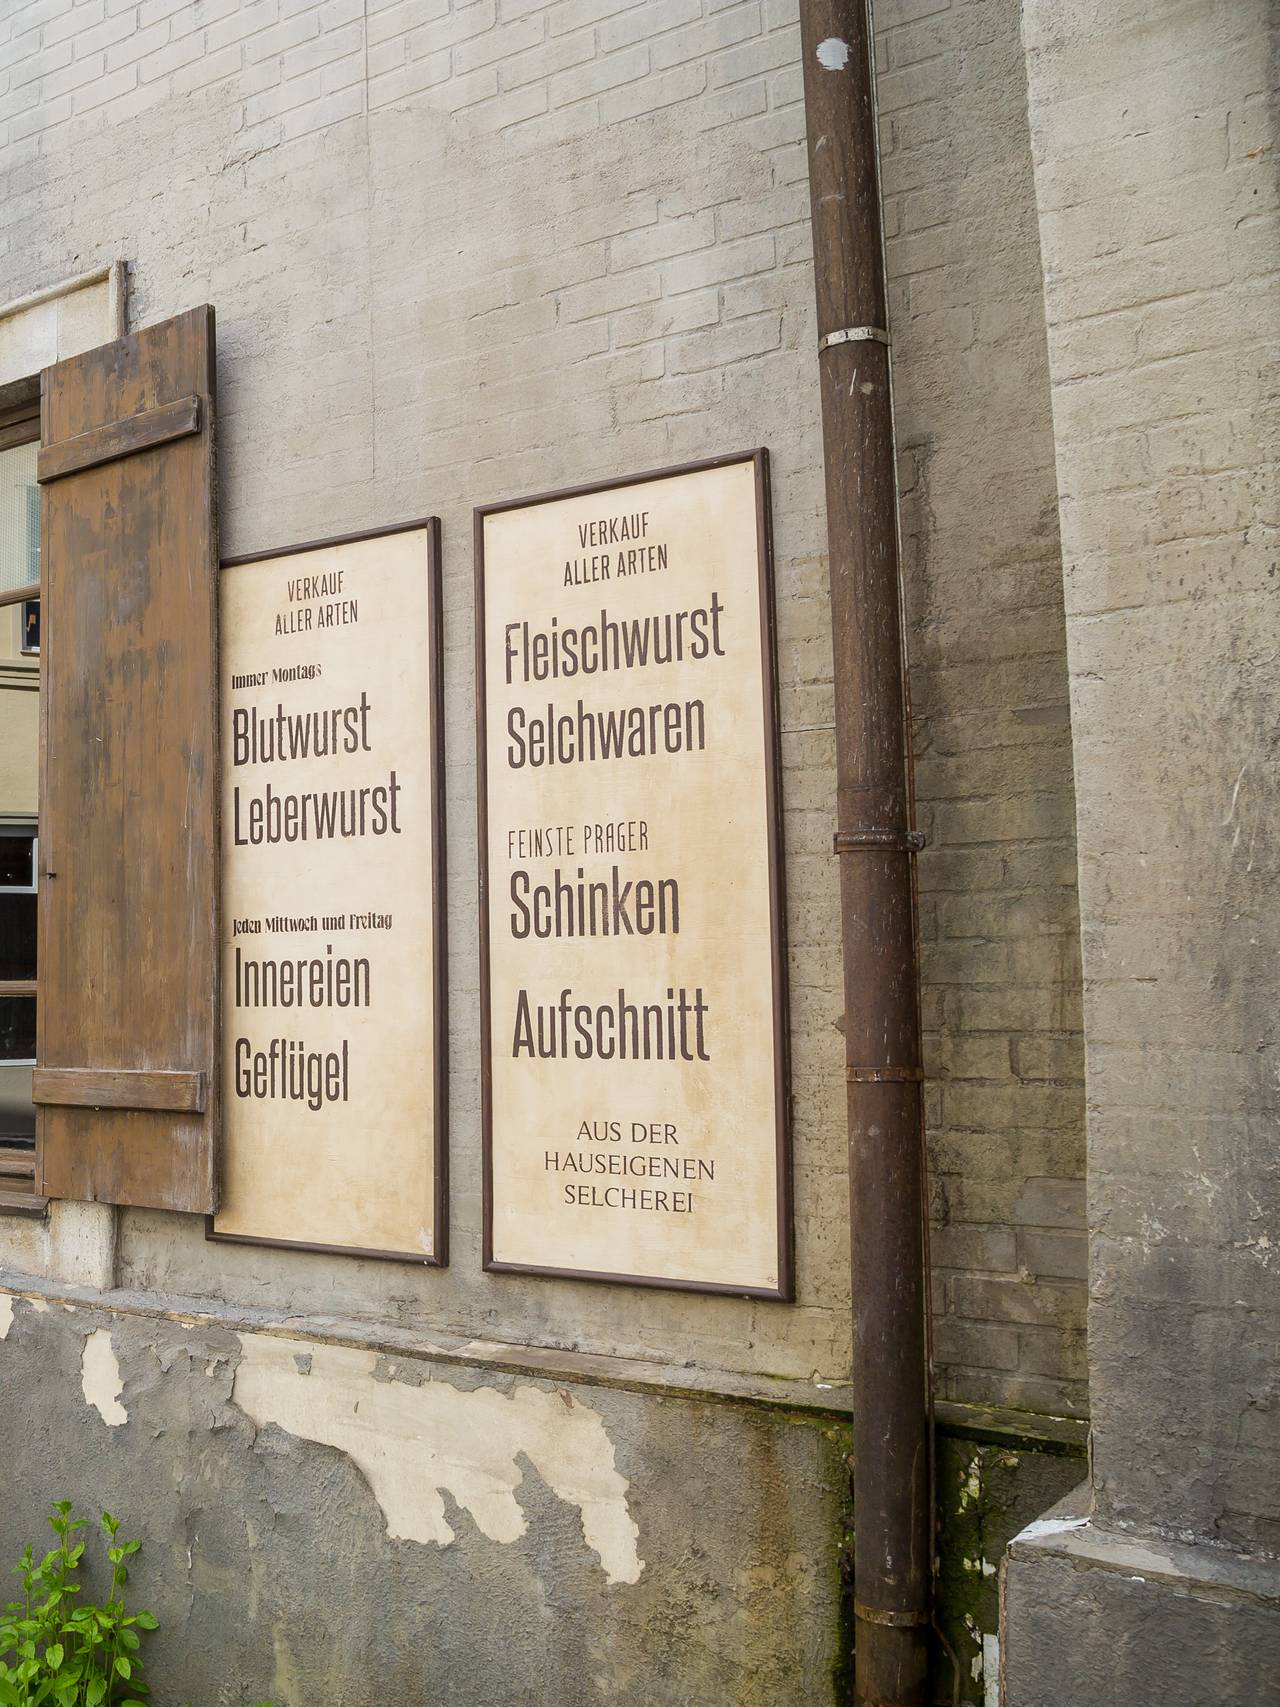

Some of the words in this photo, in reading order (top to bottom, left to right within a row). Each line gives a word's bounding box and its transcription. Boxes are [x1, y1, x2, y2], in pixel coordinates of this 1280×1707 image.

[578, 512, 649, 548] VERKAUF
[564, 554, 610, 587] ALLER
[617, 543, 668, 578] ARTEN
[287, 570, 344, 603] VERKAUF
[275, 608, 312, 636] ALLER
[318, 600, 358, 629] ARTEN
[505, 592, 725, 684] Fleischwurst
[231, 671, 268, 690] Immer
[271, 663, 322, 684] Montags
[233, 692, 371, 766] Blutwurst
[507, 699, 705, 769] Selchwaren
[234, 771, 401, 846] Leberwurst
[508, 826, 574, 859] FEINSTE
[584, 821, 648, 854] PRAGER
[510, 865, 680, 939] Schinken
[233, 918, 261, 937] Jeden
[265, 915, 318, 934] Mittwoch
[322, 914, 345, 931] und
[349, 912, 393, 930] Freitag
[235, 944, 370, 1007] Innereien
[512, 987, 710, 1062] Aufschnitt
[235, 1037, 348, 1111] Geflügel
[576, 1120, 621, 1142] AUS
[631, 1122, 679, 1144] DER
[544, 1151, 715, 1180] HAUSEIGENEN
[564, 1184, 693, 1213] SELCHEREI
